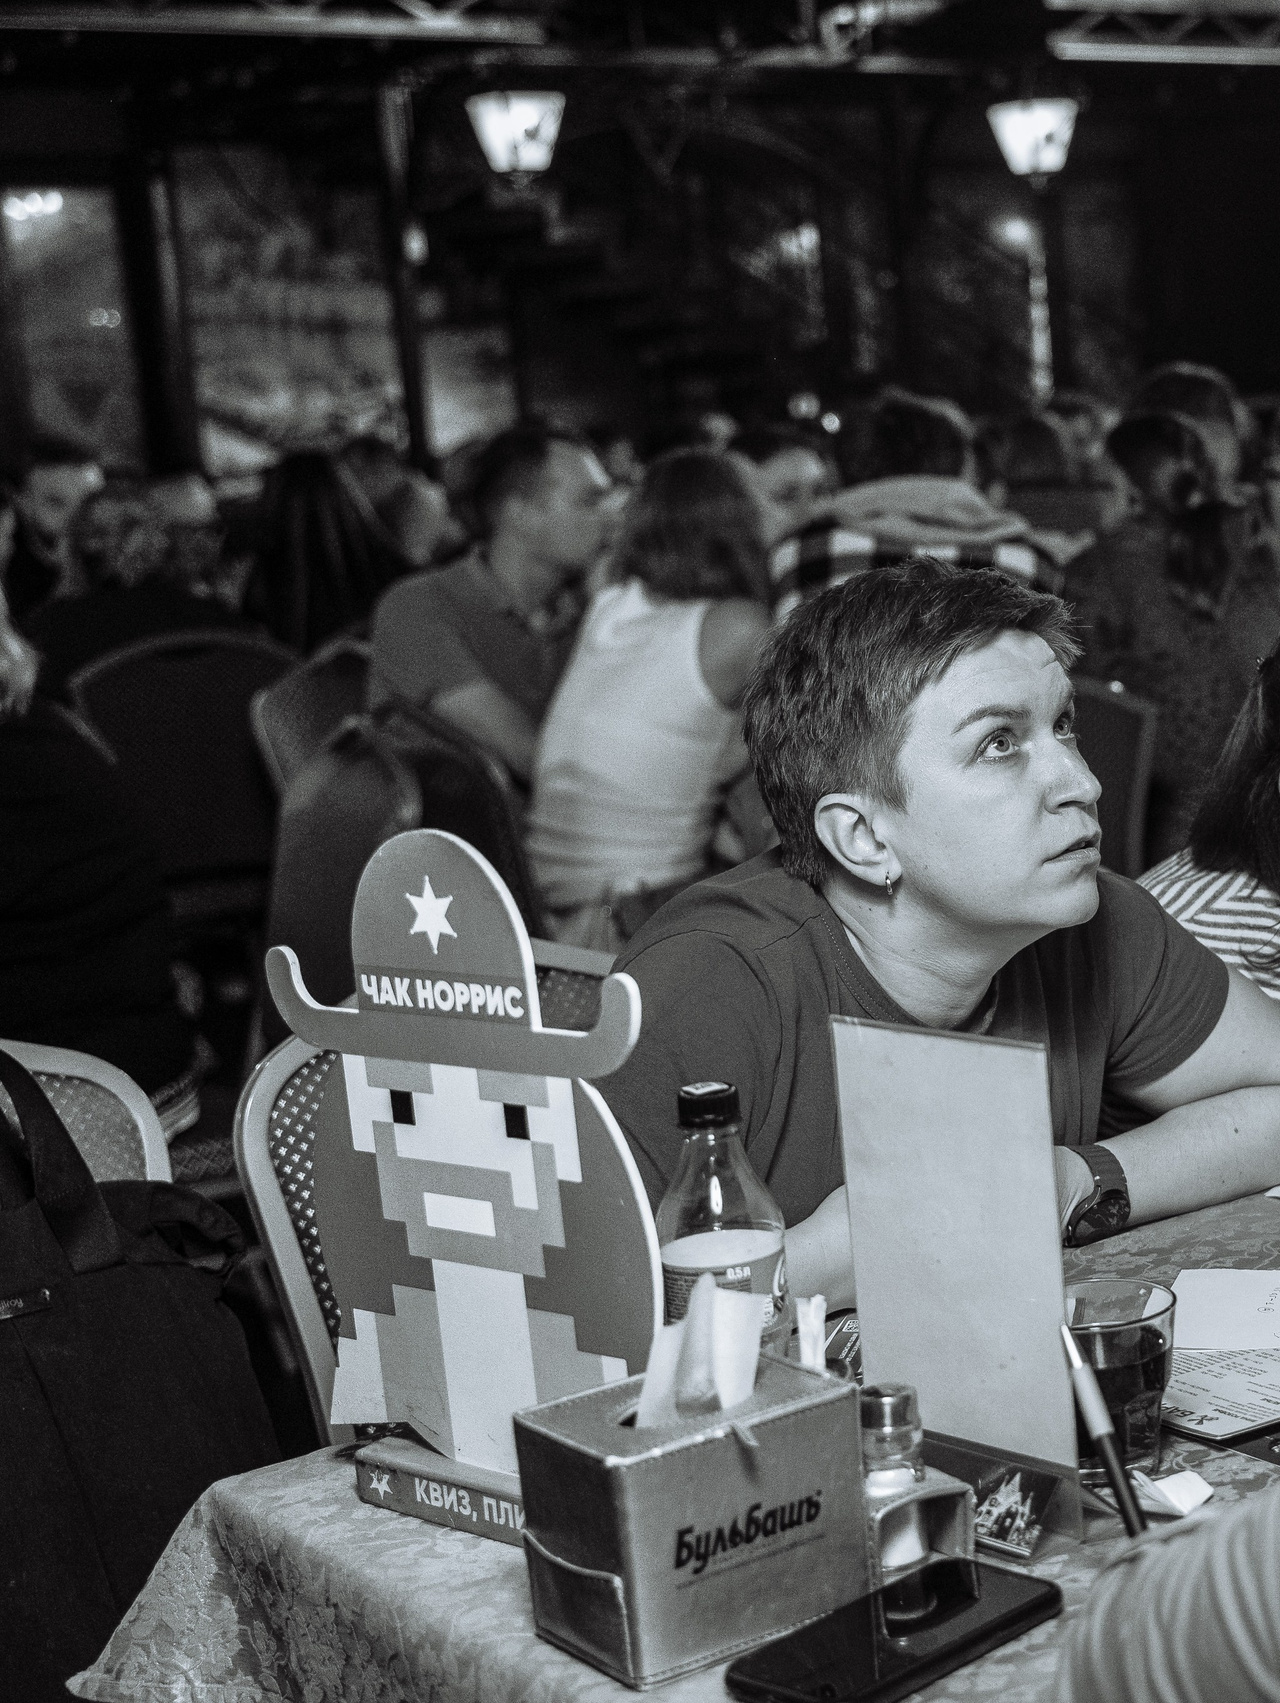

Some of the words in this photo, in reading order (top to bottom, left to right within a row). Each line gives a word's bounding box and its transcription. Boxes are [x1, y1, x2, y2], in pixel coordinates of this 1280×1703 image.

[361, 974, 414, 1008] ЧАК
[415, 978, 525, 1018] НОРРИС
[414, 1477, 478, 1522] КВИЗ,
